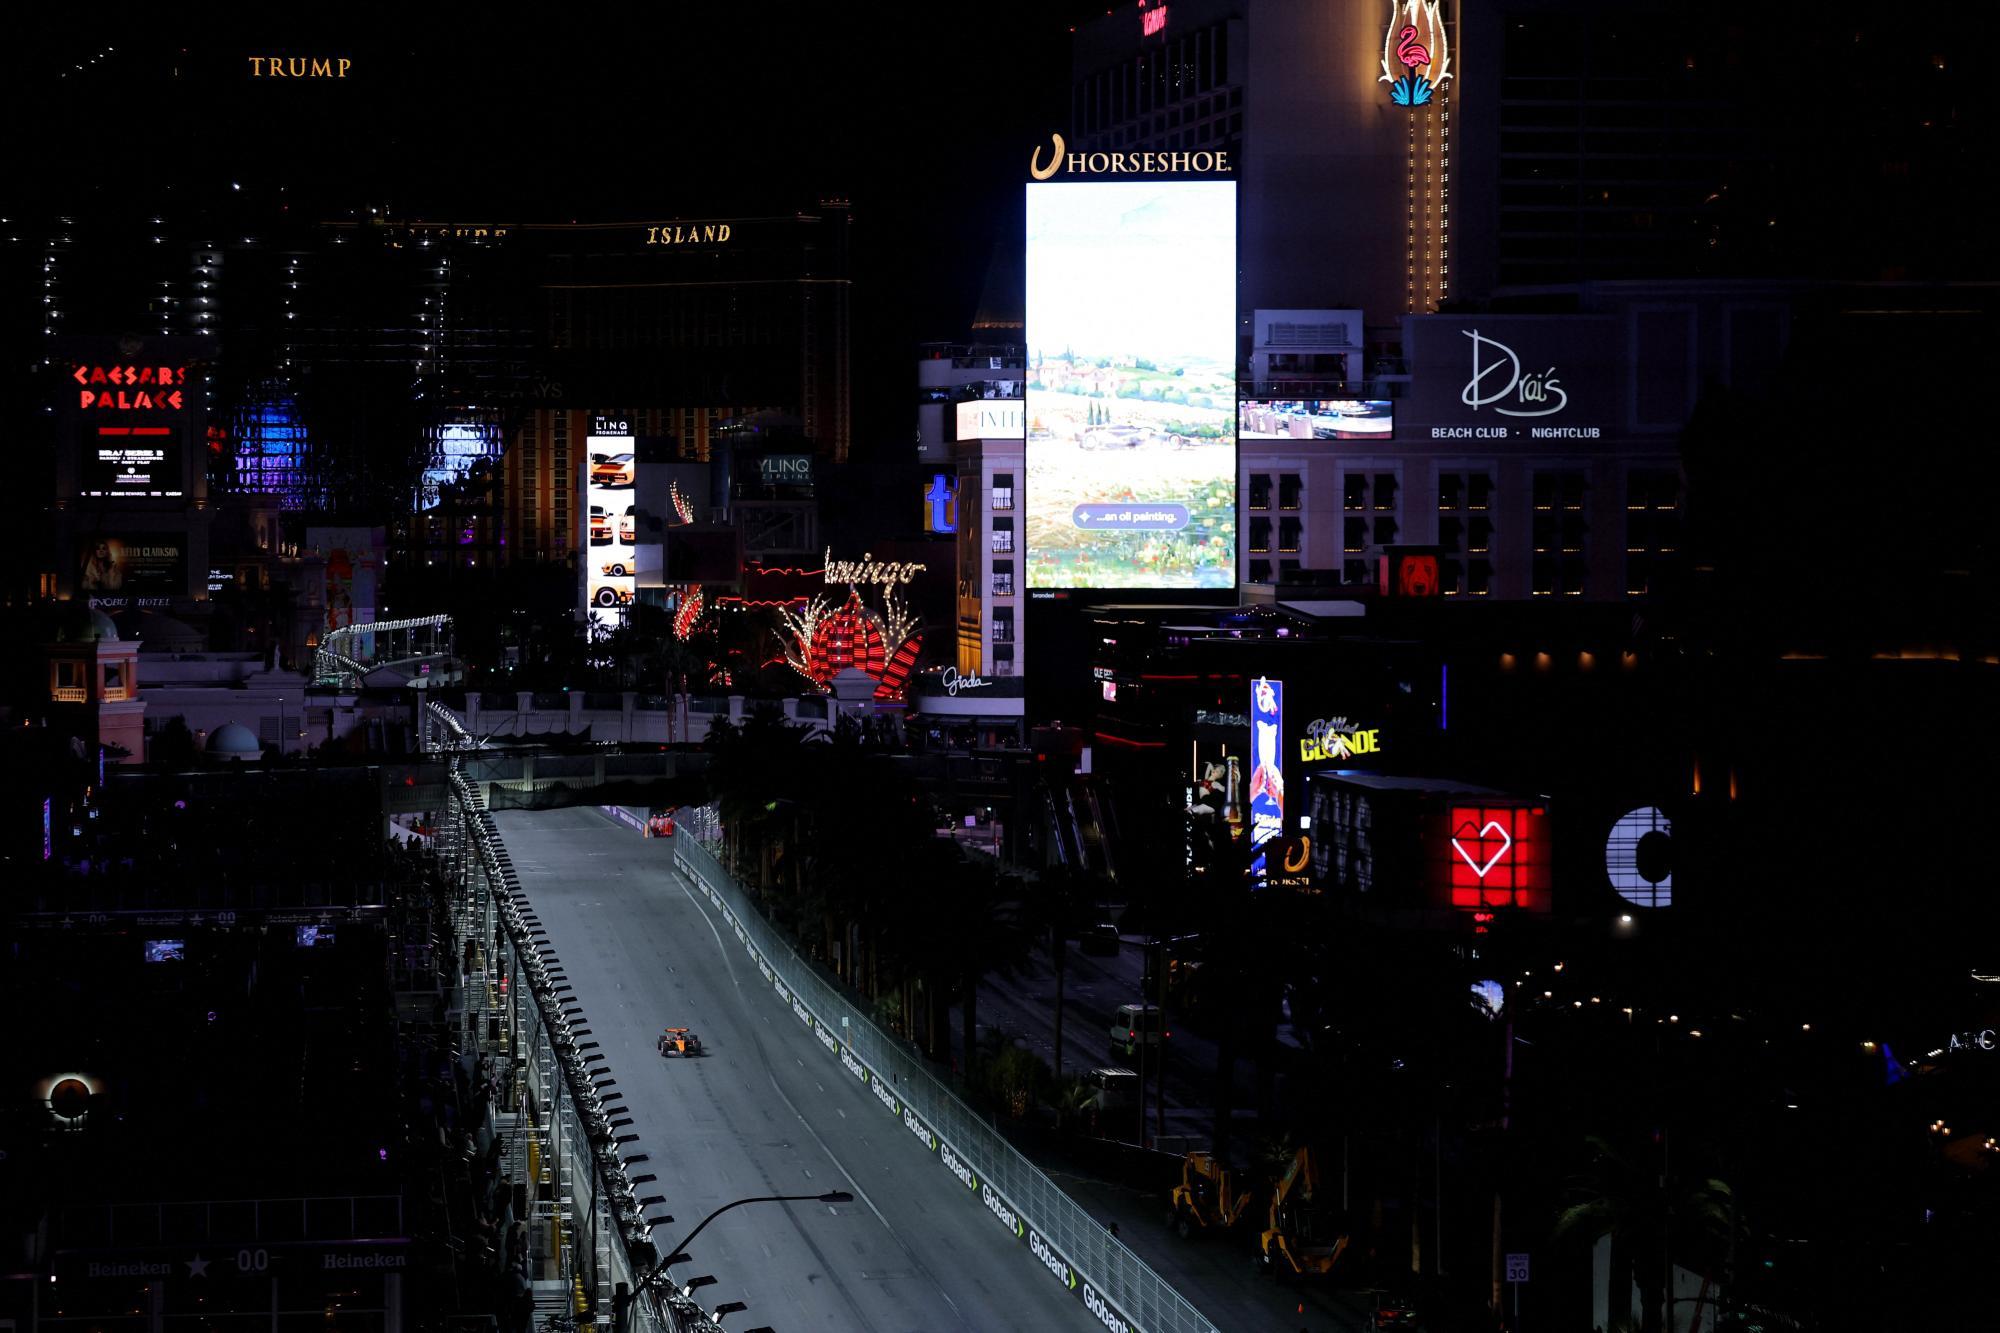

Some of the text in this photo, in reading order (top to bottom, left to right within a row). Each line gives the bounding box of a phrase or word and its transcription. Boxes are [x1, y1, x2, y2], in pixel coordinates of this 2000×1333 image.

[248, 56, 351, 78] TRUMP
[646, 223, 731, 244] ISLAND
[73, 365, 186, 385] CAESARS
[1461, 328, 1567, 417] Drai's
[80, 390, 182, 410] PALACE
[595, 421, 628, 430] LINQ
[1431, 427, 1600, 439] BEACH CLUB NIGHTCLUB
[1119, 511, 1132, 522] oil
[137, 597, 171, 607] HOTEL
[942, 666, 992, 696] Giada
[1300, 729, 1381, 762] BLONDE
[792, 996, 810, 1027] Globant
[814, 1020, 835, 1053] Globant
[840, 1046, 865, 1082] Globant
[871, 1075, 897, 1114] Globant
[903, 1107, 932, 1149] Globant
[940, 1143, 972, 1189] Globant
[982, 1183, 1018, 1235] Globant
[88, 1260, 172, 1278] Heineken
[323, 1252, 407, 1269] Heineken
[1029, 1230, 1070, 1286] Globant
[1510, 1269, 1527, 1279] 30
